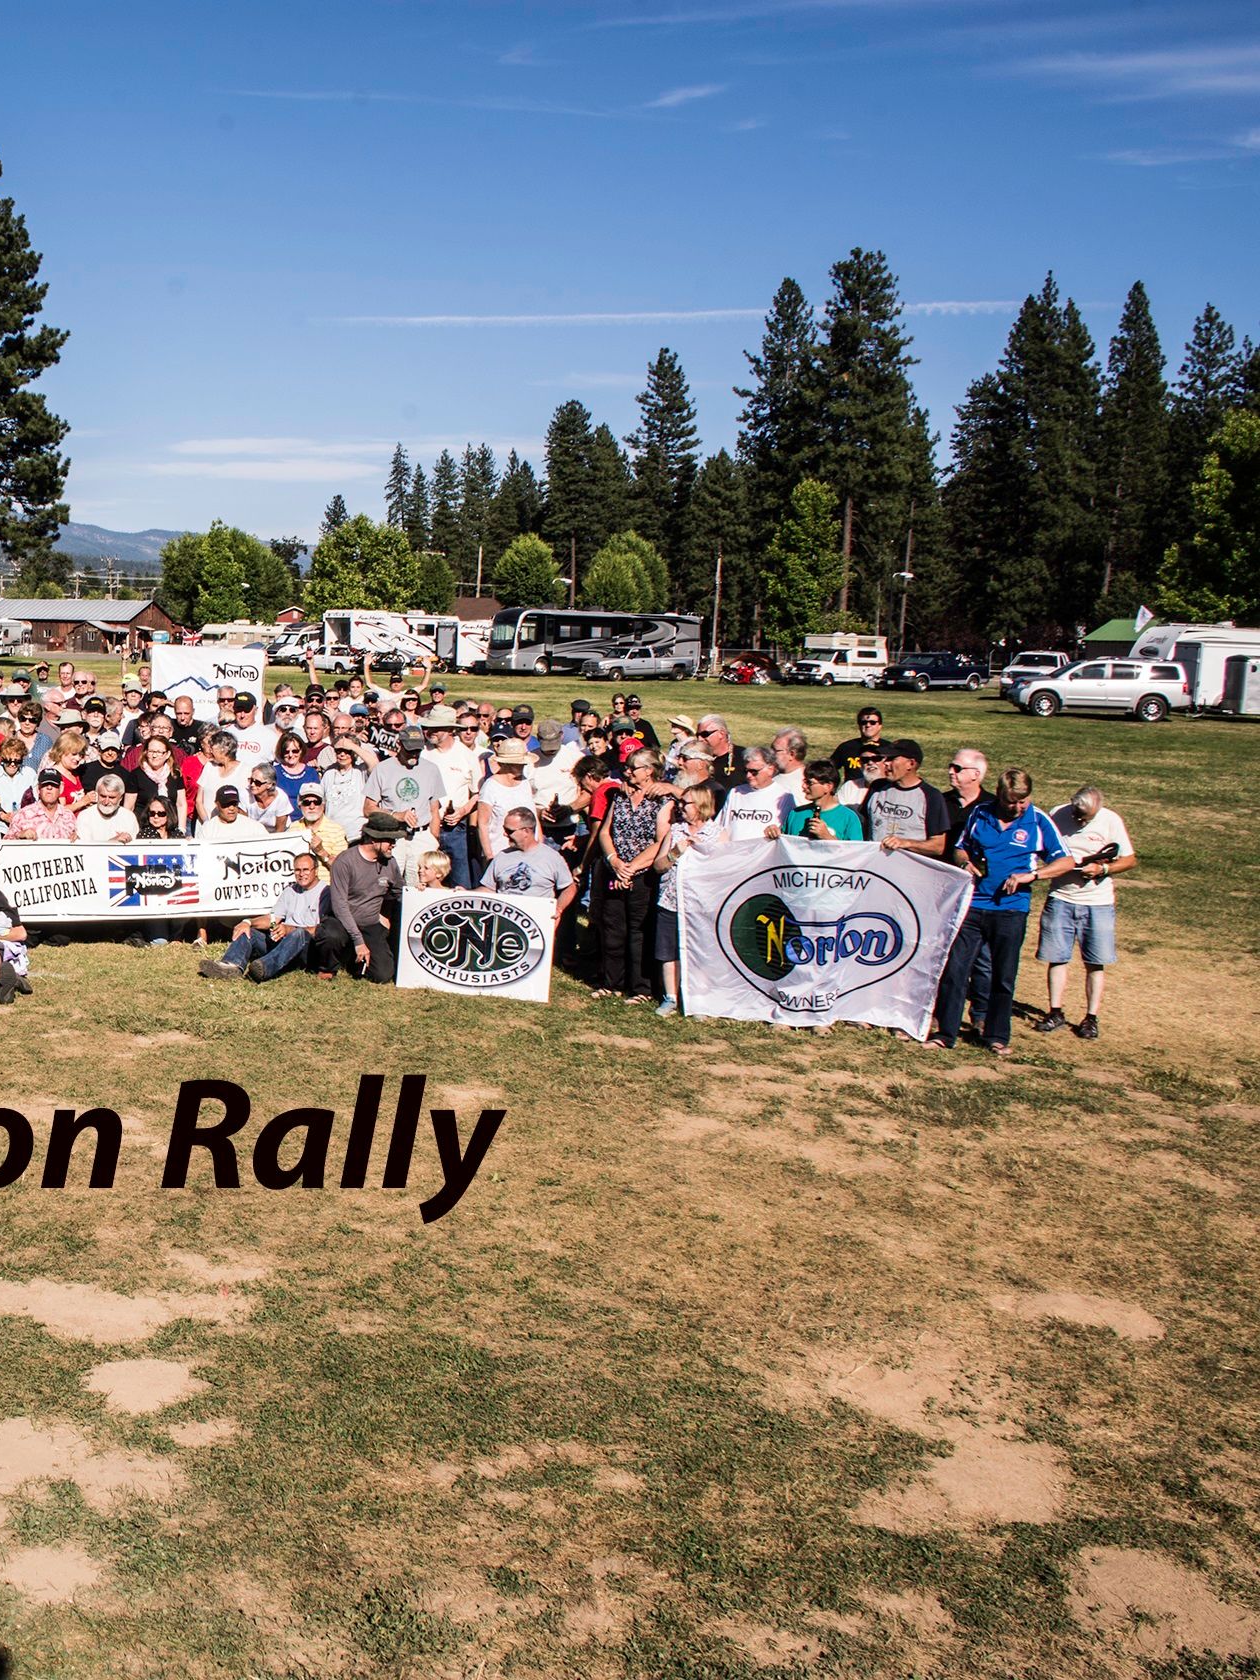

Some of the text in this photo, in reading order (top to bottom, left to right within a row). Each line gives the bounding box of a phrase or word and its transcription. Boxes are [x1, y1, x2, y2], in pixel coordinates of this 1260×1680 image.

[213, 663, 259, 681] Norton
[236, 741, 261, 753] rton
[730, 808, 773, 824] Norton
[873, 800, 913, 819] Norton
[3, 854, 85, 884] NORTHERN
[215, 849, 299, 881] Norton
[14, 877, 98, 908] CALIFORNIA
[131, 872, 176, 889] Norton
[772, 871, 871, 891] MICHIGAN
[413, 900, 540, 940] OREGON NORTON
[756, 911, 903, 968] Norton
[418, 951, 531, 984] ENTHUSIASTS
